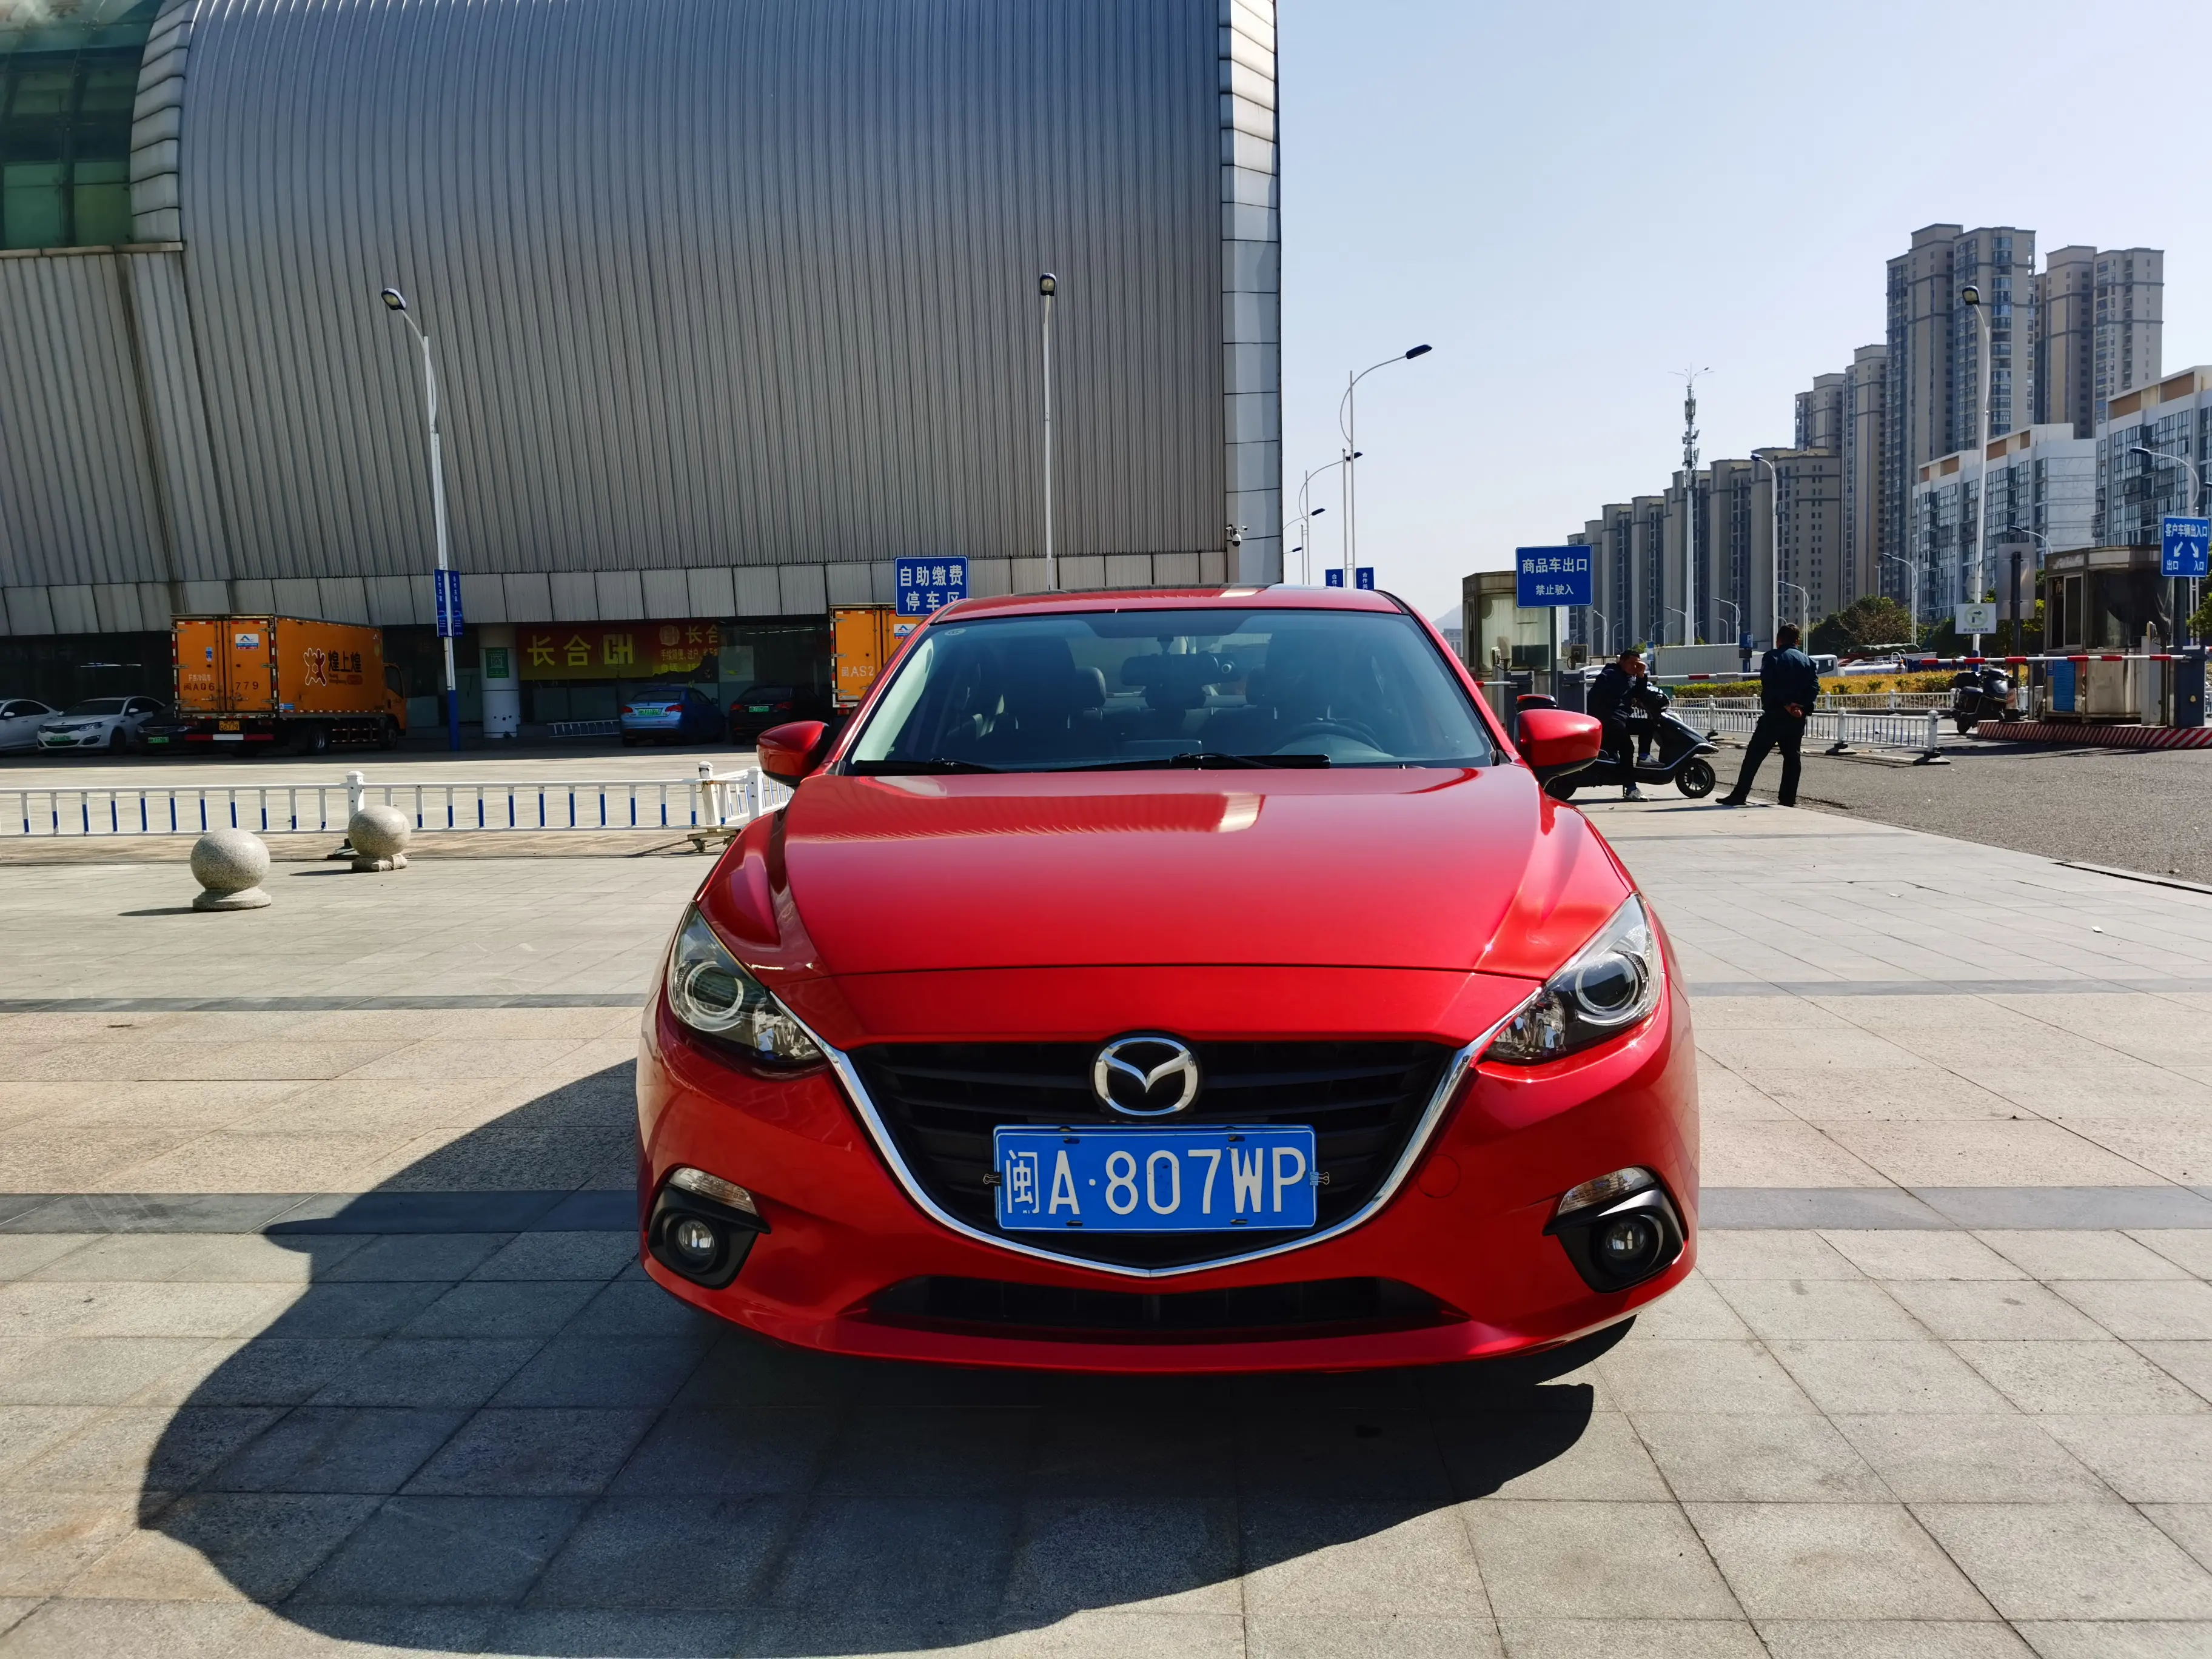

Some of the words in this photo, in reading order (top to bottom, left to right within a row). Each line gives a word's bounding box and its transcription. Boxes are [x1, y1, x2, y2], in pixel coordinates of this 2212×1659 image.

[2165, 523, 2207, 538] 客户车辆出入口
[1522, 557, 1587, 574] 商品车出口
[2166, 559, 2179, 571] 出口
[2193, 560, 2204, 571] 入口
[900, 565, 963, 587] 自助缴费
[1535, 584, 1574, 595] 禁止驶入
[906, 591, 960, 612] 停车区
[527, 634, 592, 666] 长合
[327, 650, 363, 672] 煌上煌
